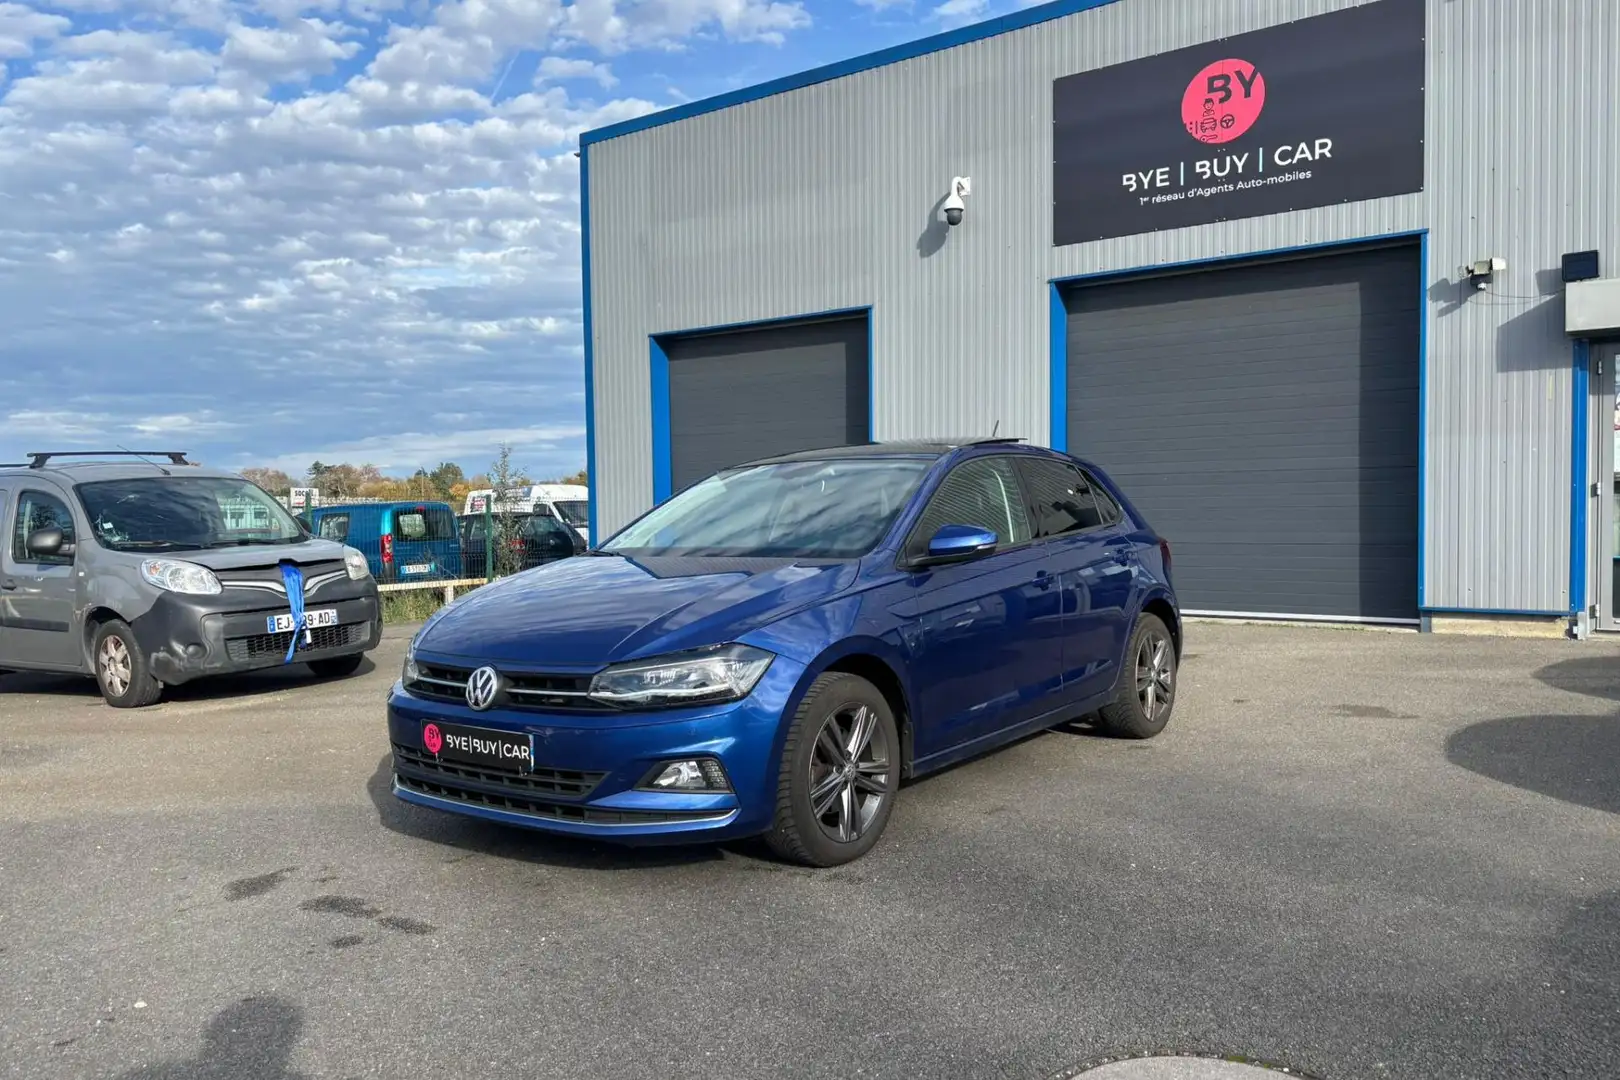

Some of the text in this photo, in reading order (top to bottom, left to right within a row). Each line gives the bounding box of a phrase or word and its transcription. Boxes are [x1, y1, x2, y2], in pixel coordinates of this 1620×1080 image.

[1206, 66, 1258, 104] BY
[1122, 138, 1333, 192] BYE BUY CAR
[1152, 192, 1185, 204] réseau
[1188, 183, 1234, 198] d'Agents
[1236, 170, 1313, 190] Auto-mobiles
